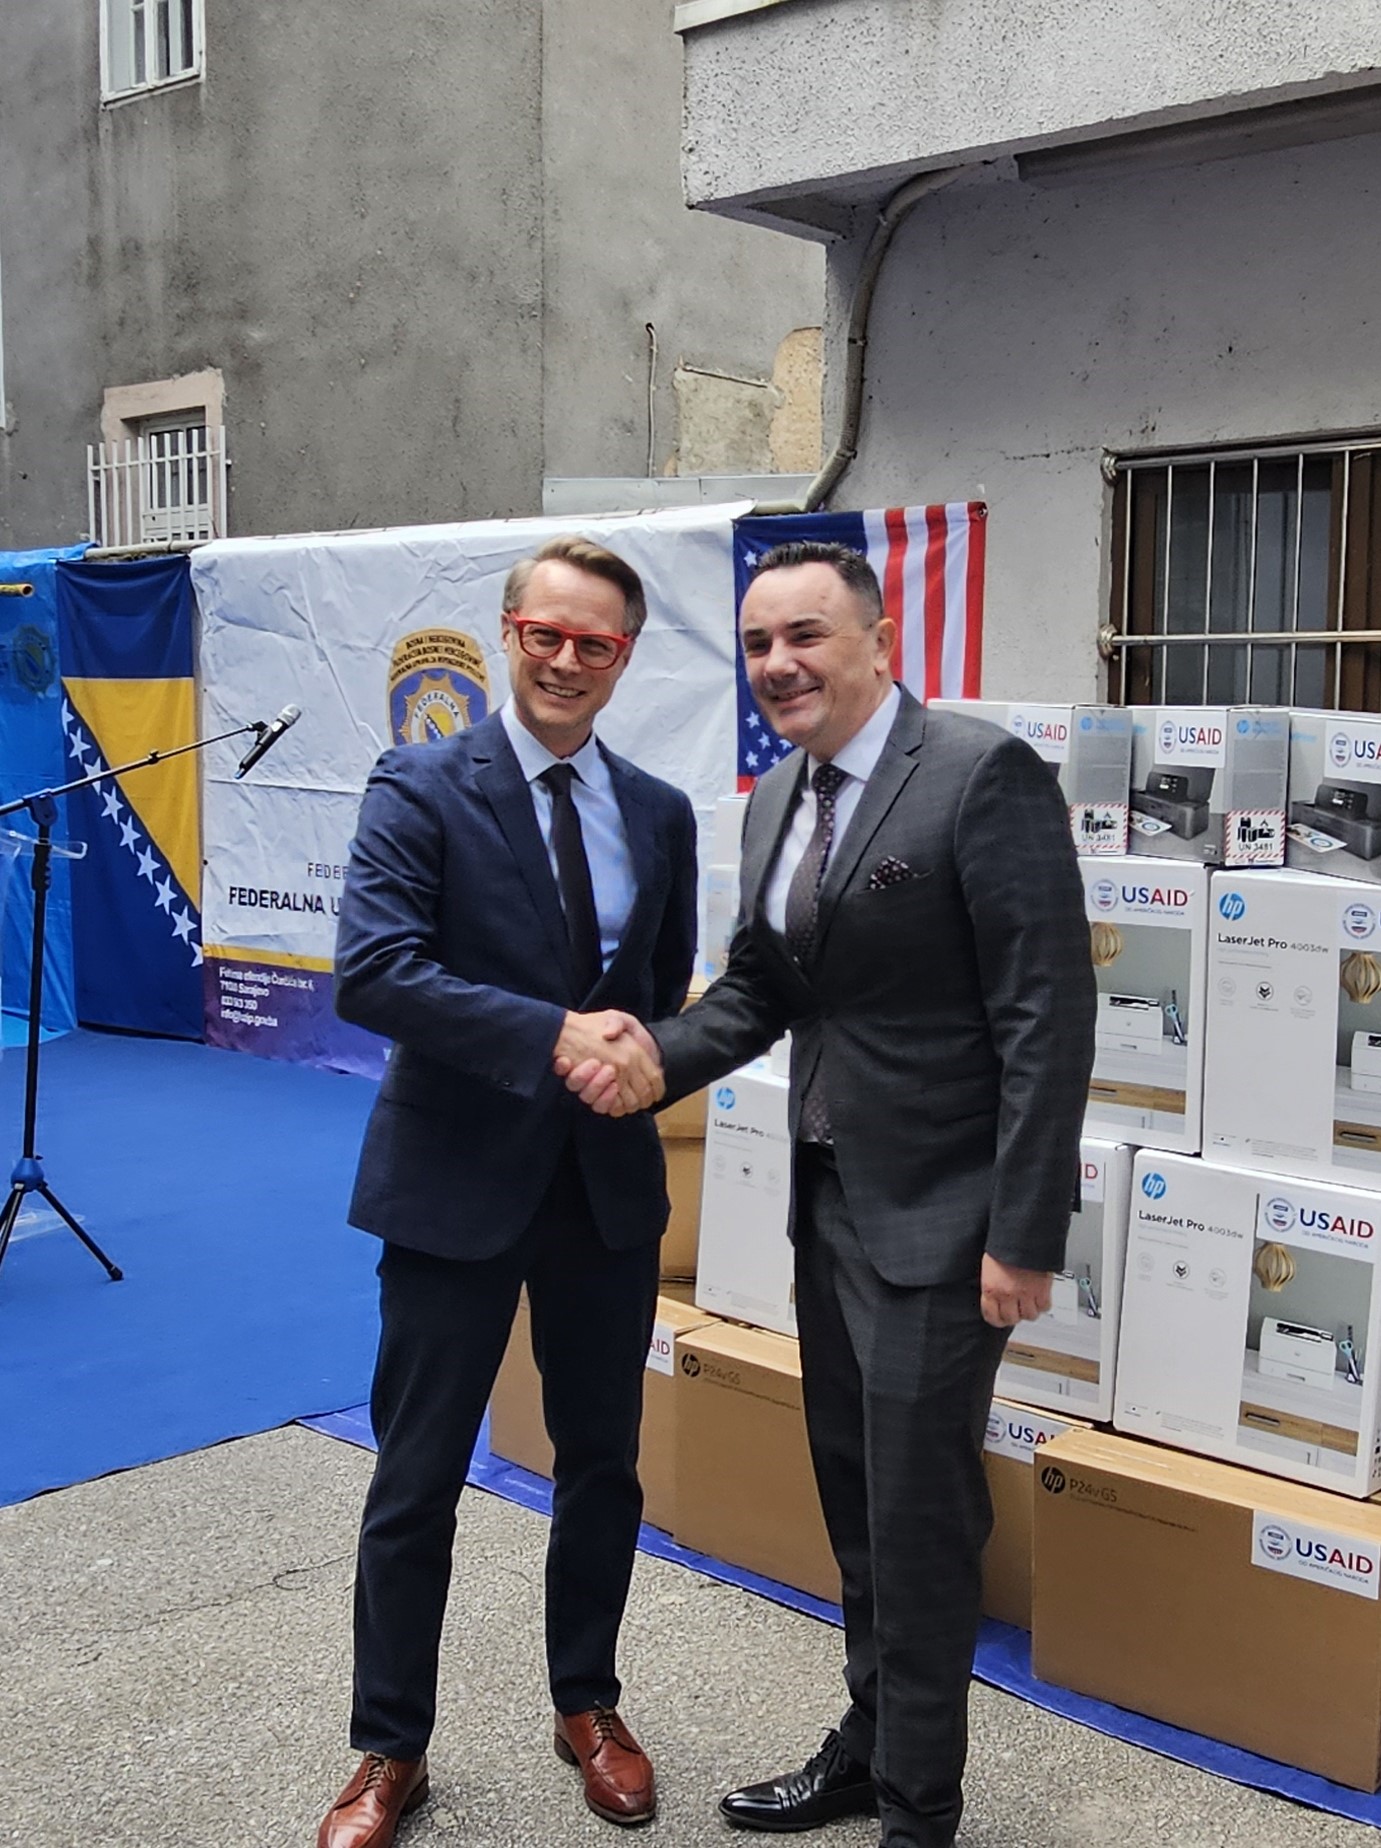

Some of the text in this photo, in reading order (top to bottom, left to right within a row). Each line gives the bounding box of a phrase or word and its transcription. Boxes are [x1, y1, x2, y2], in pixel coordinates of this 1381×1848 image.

[1027, 721, 1067, 741] USAID
[1178, 726, 1222, 745] USAID
[228, 885, 341, 917] FEDERALNA U
[1121, 885, 1188, 907] USAID
[1219, 893, 1245, 921] hp
[1217, 933, 1265, 948] LaserJet
[1268, 938, 1288, 950] Pro
[1142, 1172, 1166, 1200] hp
[1138, 1209, 1184, 1228] LaserJet
[1186, 1219, 1205, 1232] Pro
[1299, 1207, 1374, 1239] USAID
[650, 1339, 670, 1356] AID
[682, 1353, 700, 1378] hp
[1008, 1422, 1055, 1446] USA
[1041, 1466, 1066, 1494] hp
[1296, 1537, 1373, 1574] USAID
